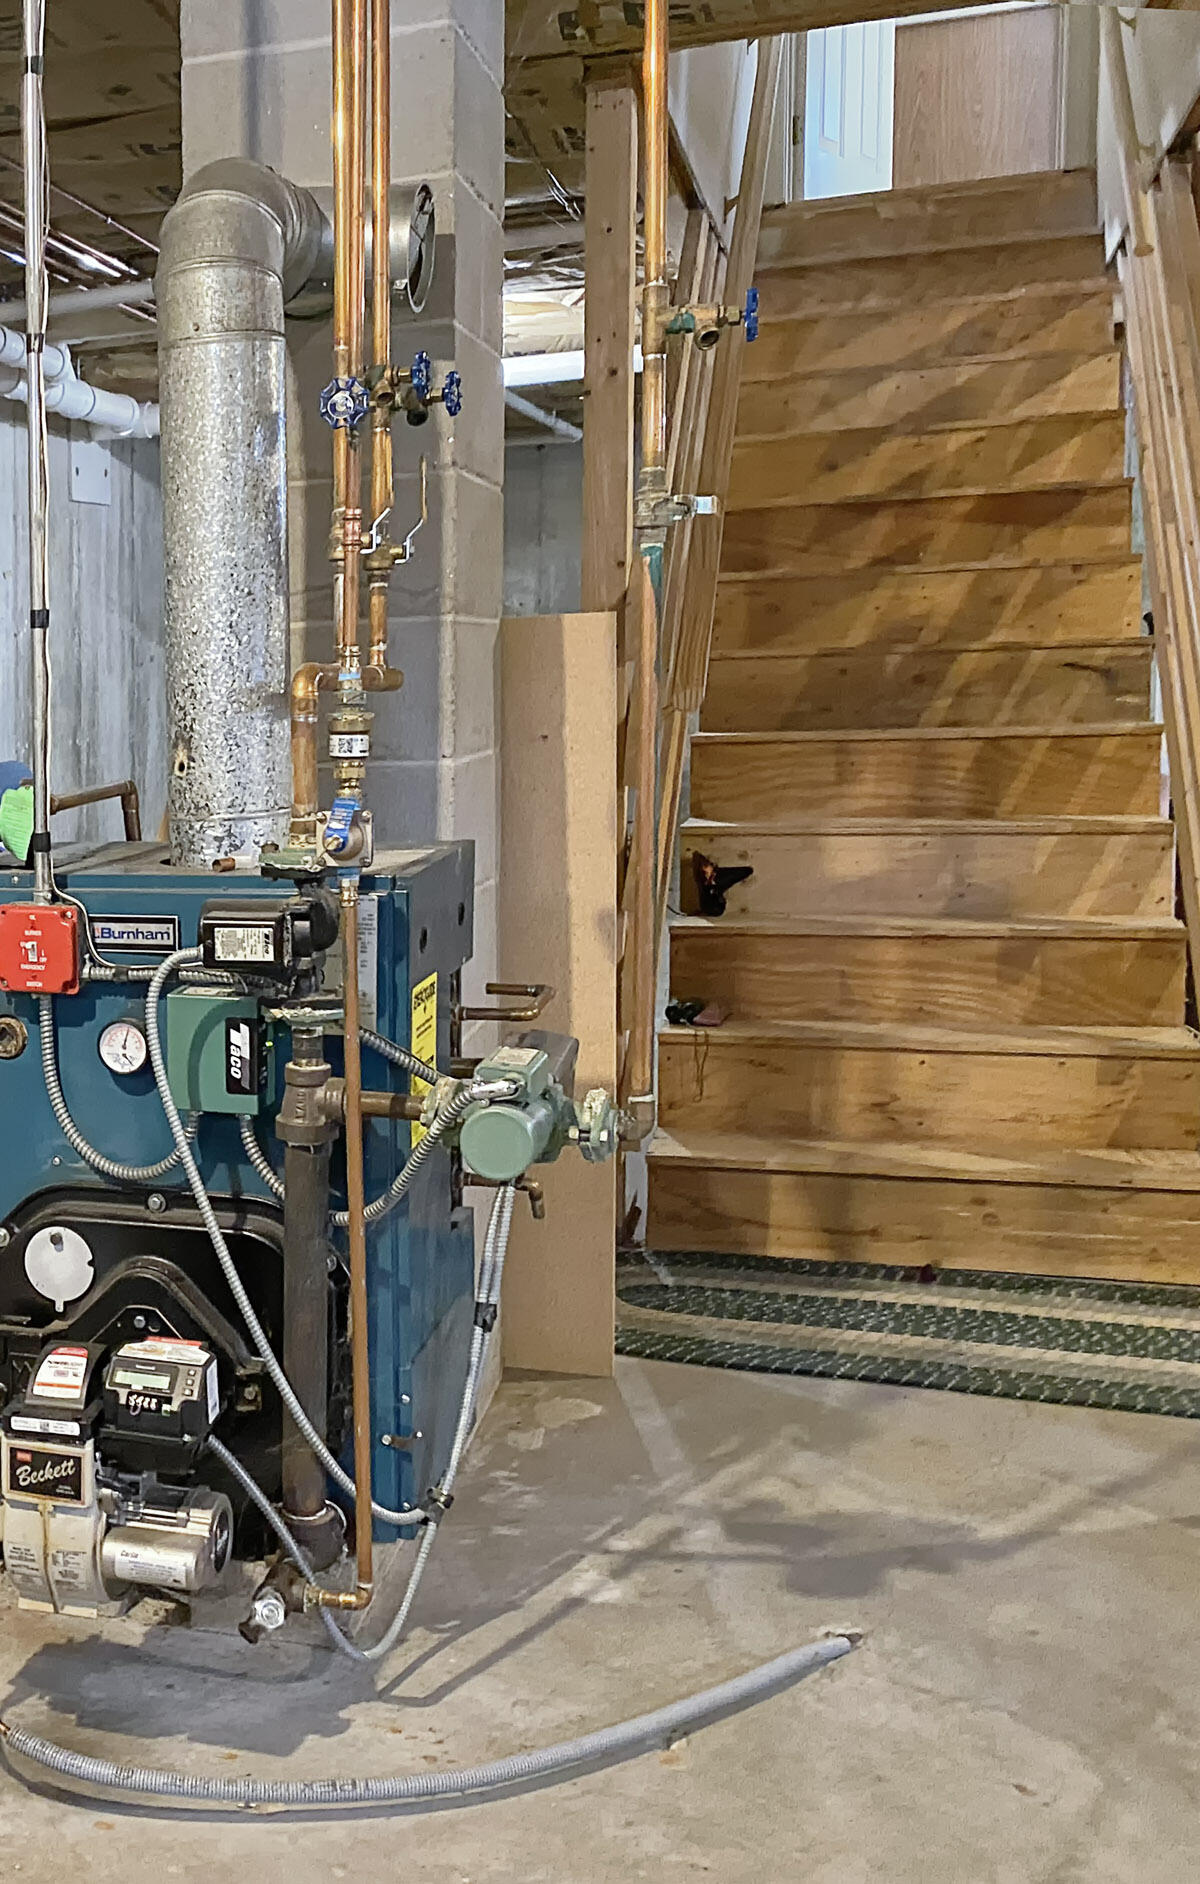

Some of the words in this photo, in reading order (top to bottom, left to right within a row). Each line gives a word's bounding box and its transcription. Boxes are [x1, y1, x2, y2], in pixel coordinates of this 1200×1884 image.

[100, 927, 170, 940] Burnham
[229, 1022, 251, 1080] Taco
[15, 1458, 76, 1487] Beckett
